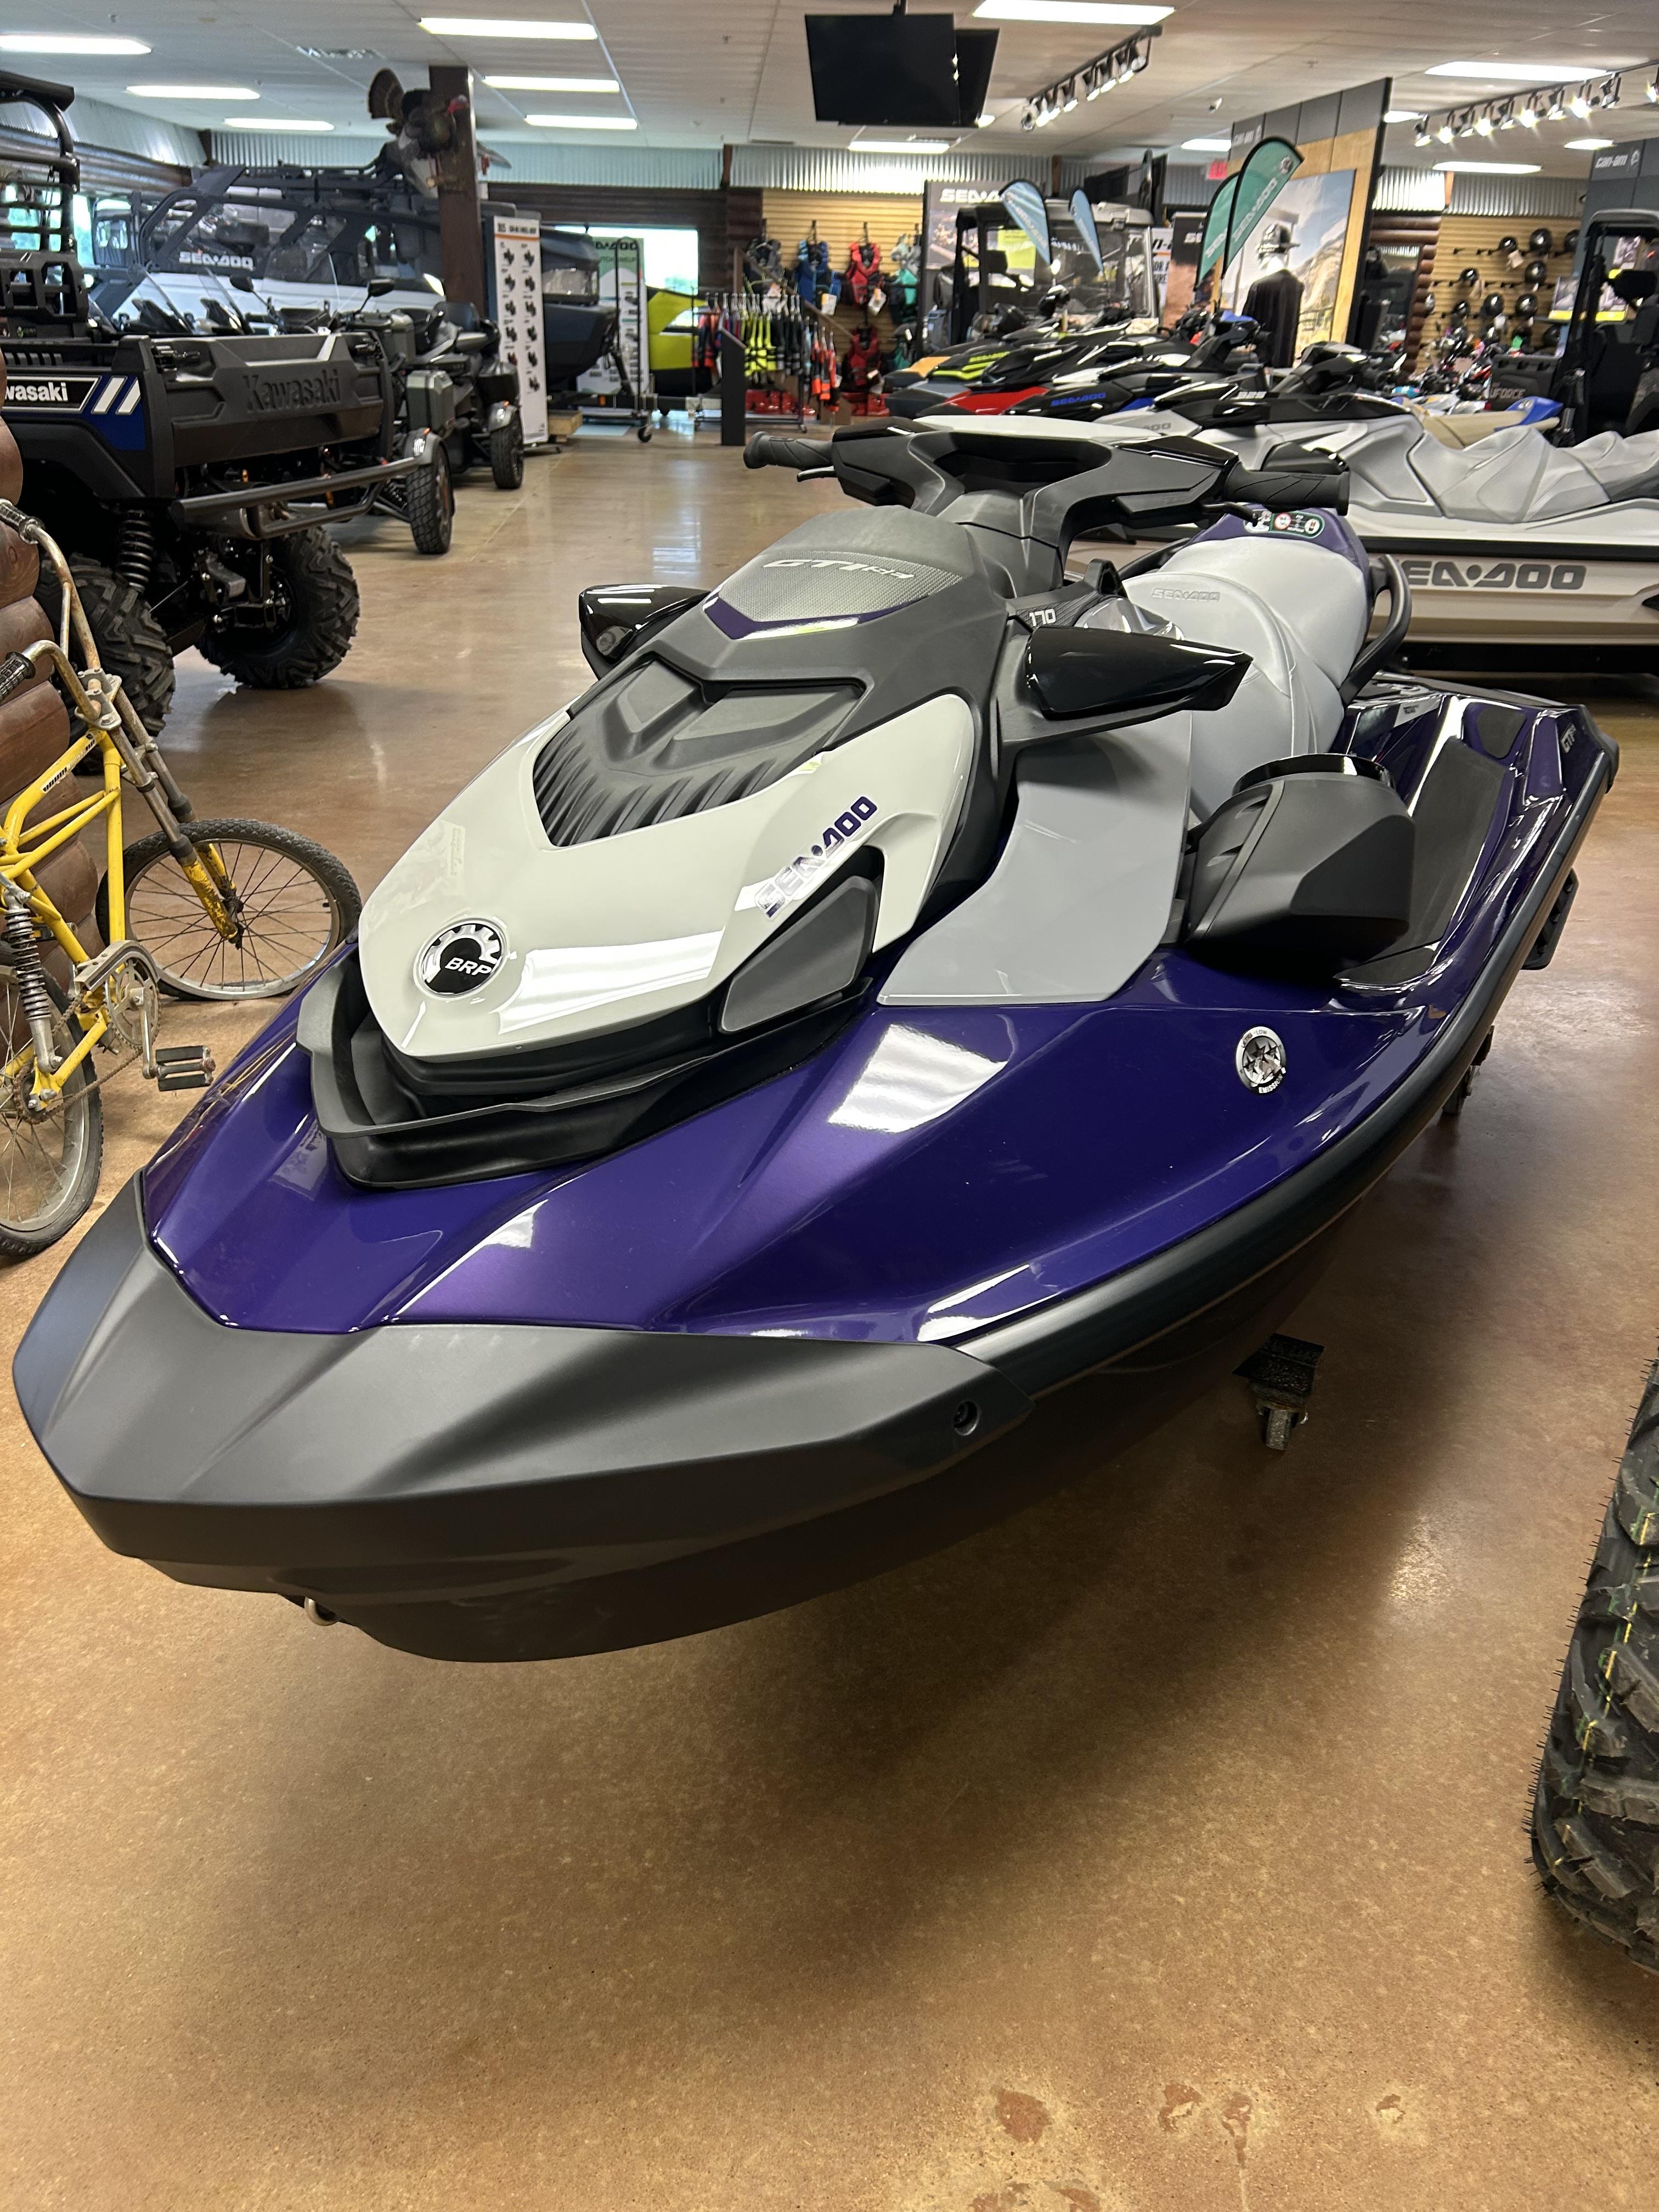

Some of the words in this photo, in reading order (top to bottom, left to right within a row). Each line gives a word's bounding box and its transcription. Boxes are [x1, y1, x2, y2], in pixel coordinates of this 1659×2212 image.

[5, 382, 68, 402] wasaki
[243, 369, 341, 410] Kawasaki
[1029, 608, 1056, 627] 170
[444, 957, 493, 976] BRP
